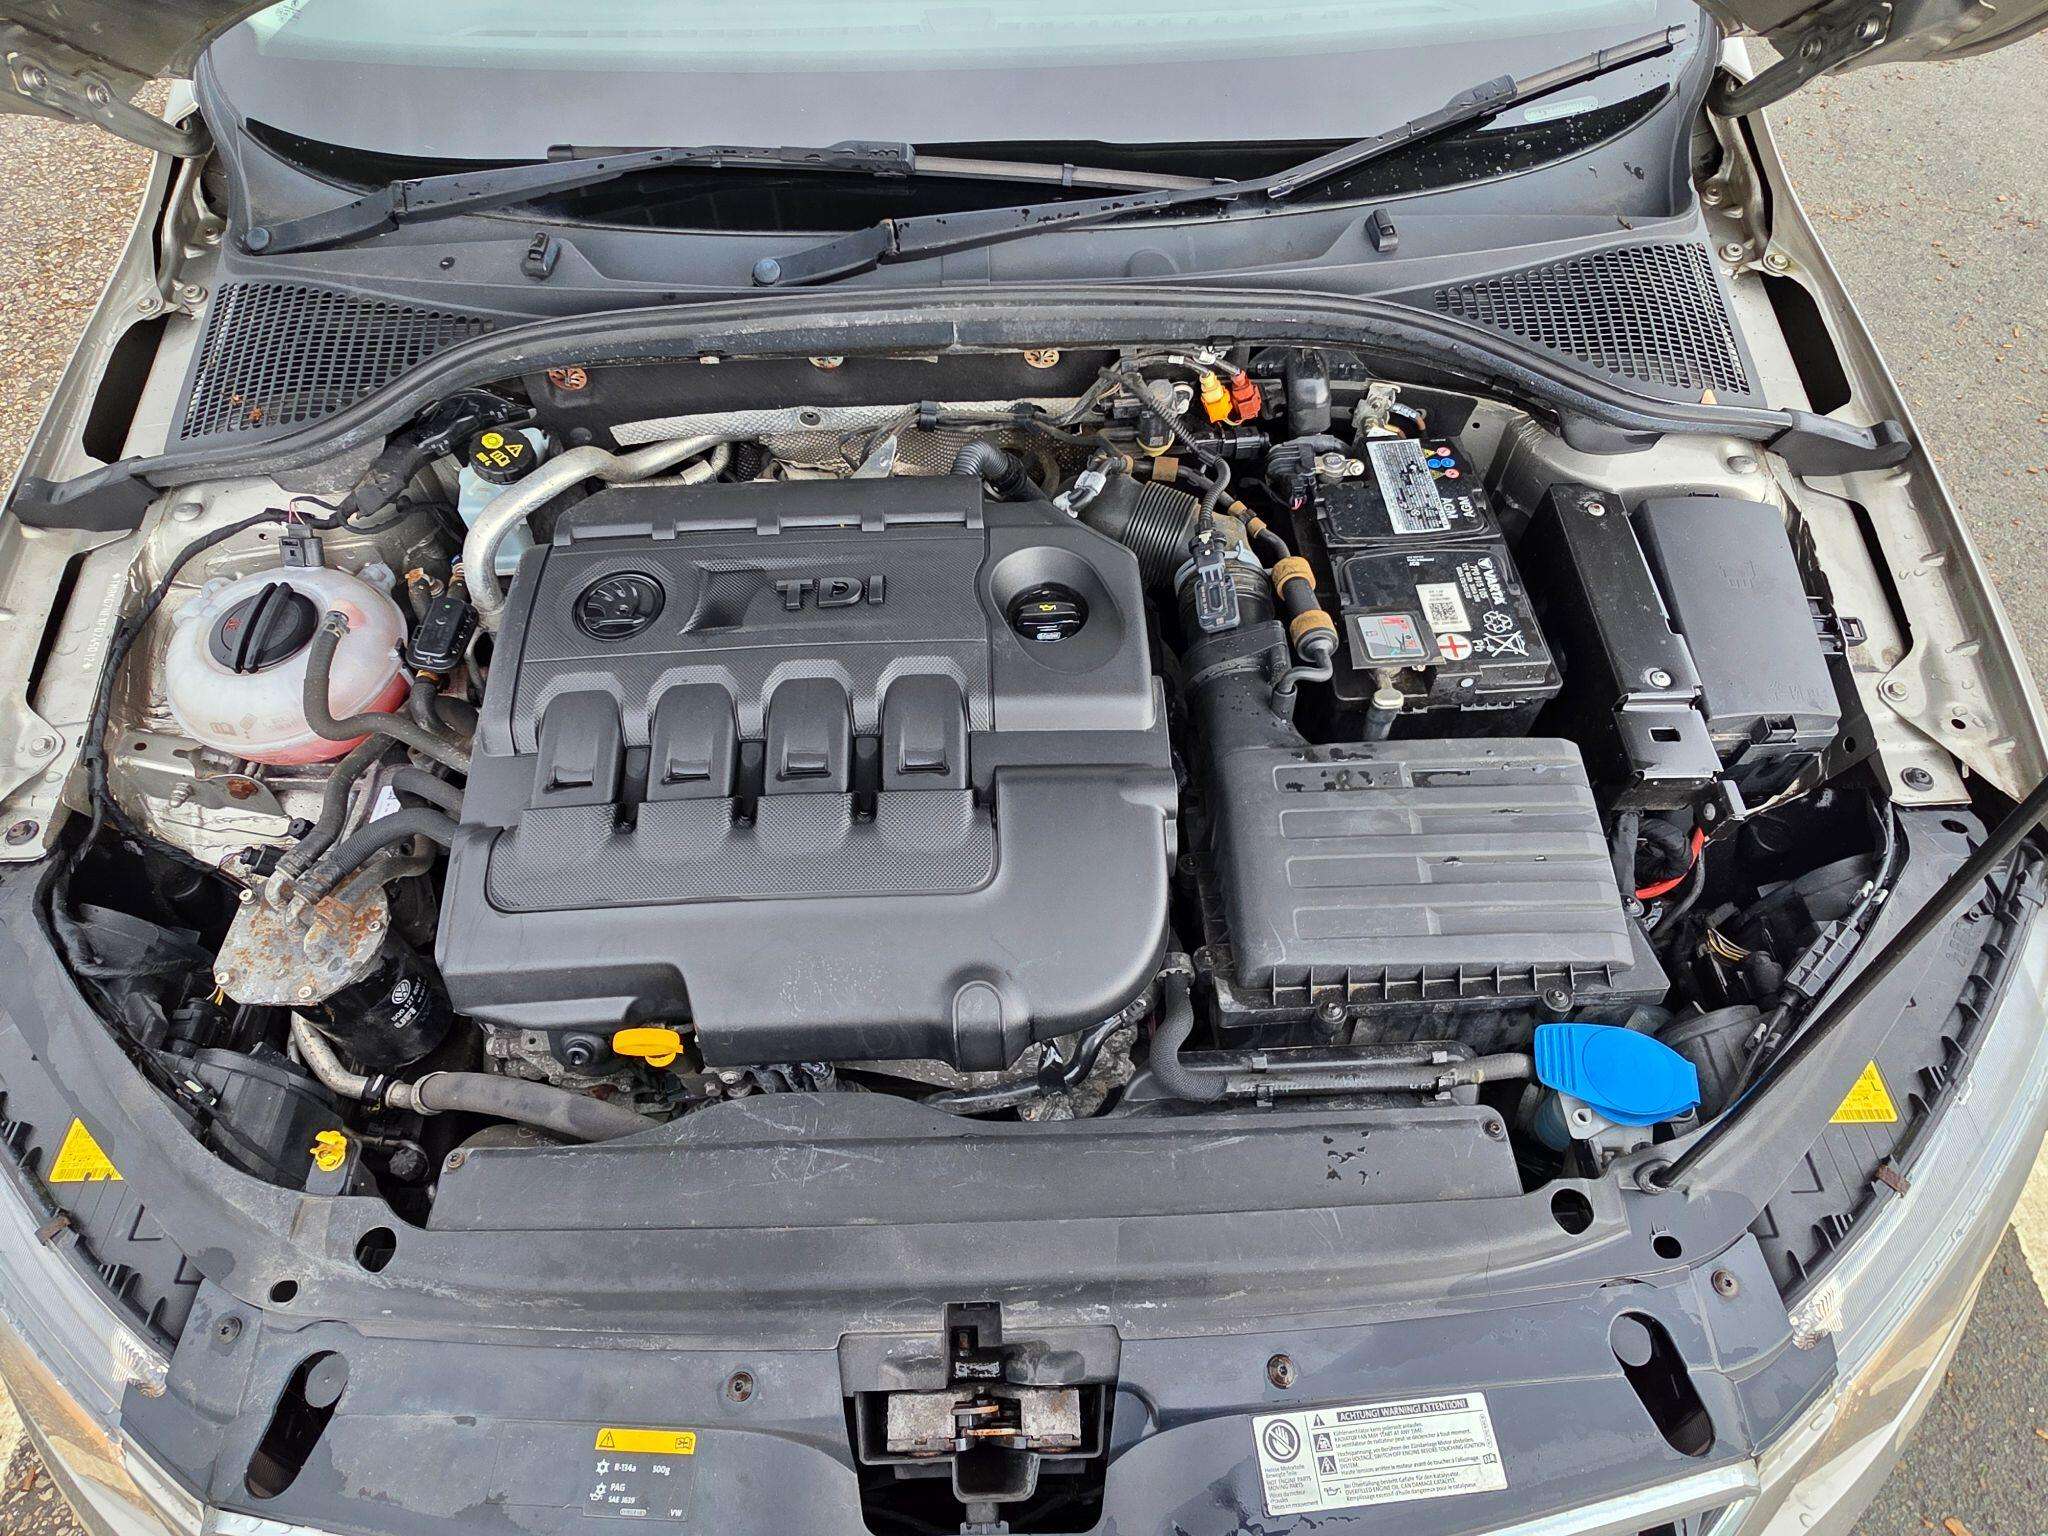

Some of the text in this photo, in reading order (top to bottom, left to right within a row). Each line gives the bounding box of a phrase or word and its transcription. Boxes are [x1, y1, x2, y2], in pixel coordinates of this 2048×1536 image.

[1441, 497, 1458, 518] AGM
[1457, 496, 1476, 518] AGM
[775, 574, 886, 610] TDI
[1484, 569, 1507, 605] VARTA
[1471, 640, 1484, 652] Pb
[404, 995, 414, 1008] 127
[393, 1006, 417, 1028] UFI
[1340, 1399, 1467, 1421] ACHTUNG! WARNING! ATTENTION!
[652, 1465, 671, 1476] 500g
[610, 1483, 626, 1491] PAG
[608, 1495, 620, 1503] SAE
[670, 1508, 682, 1517] VW
